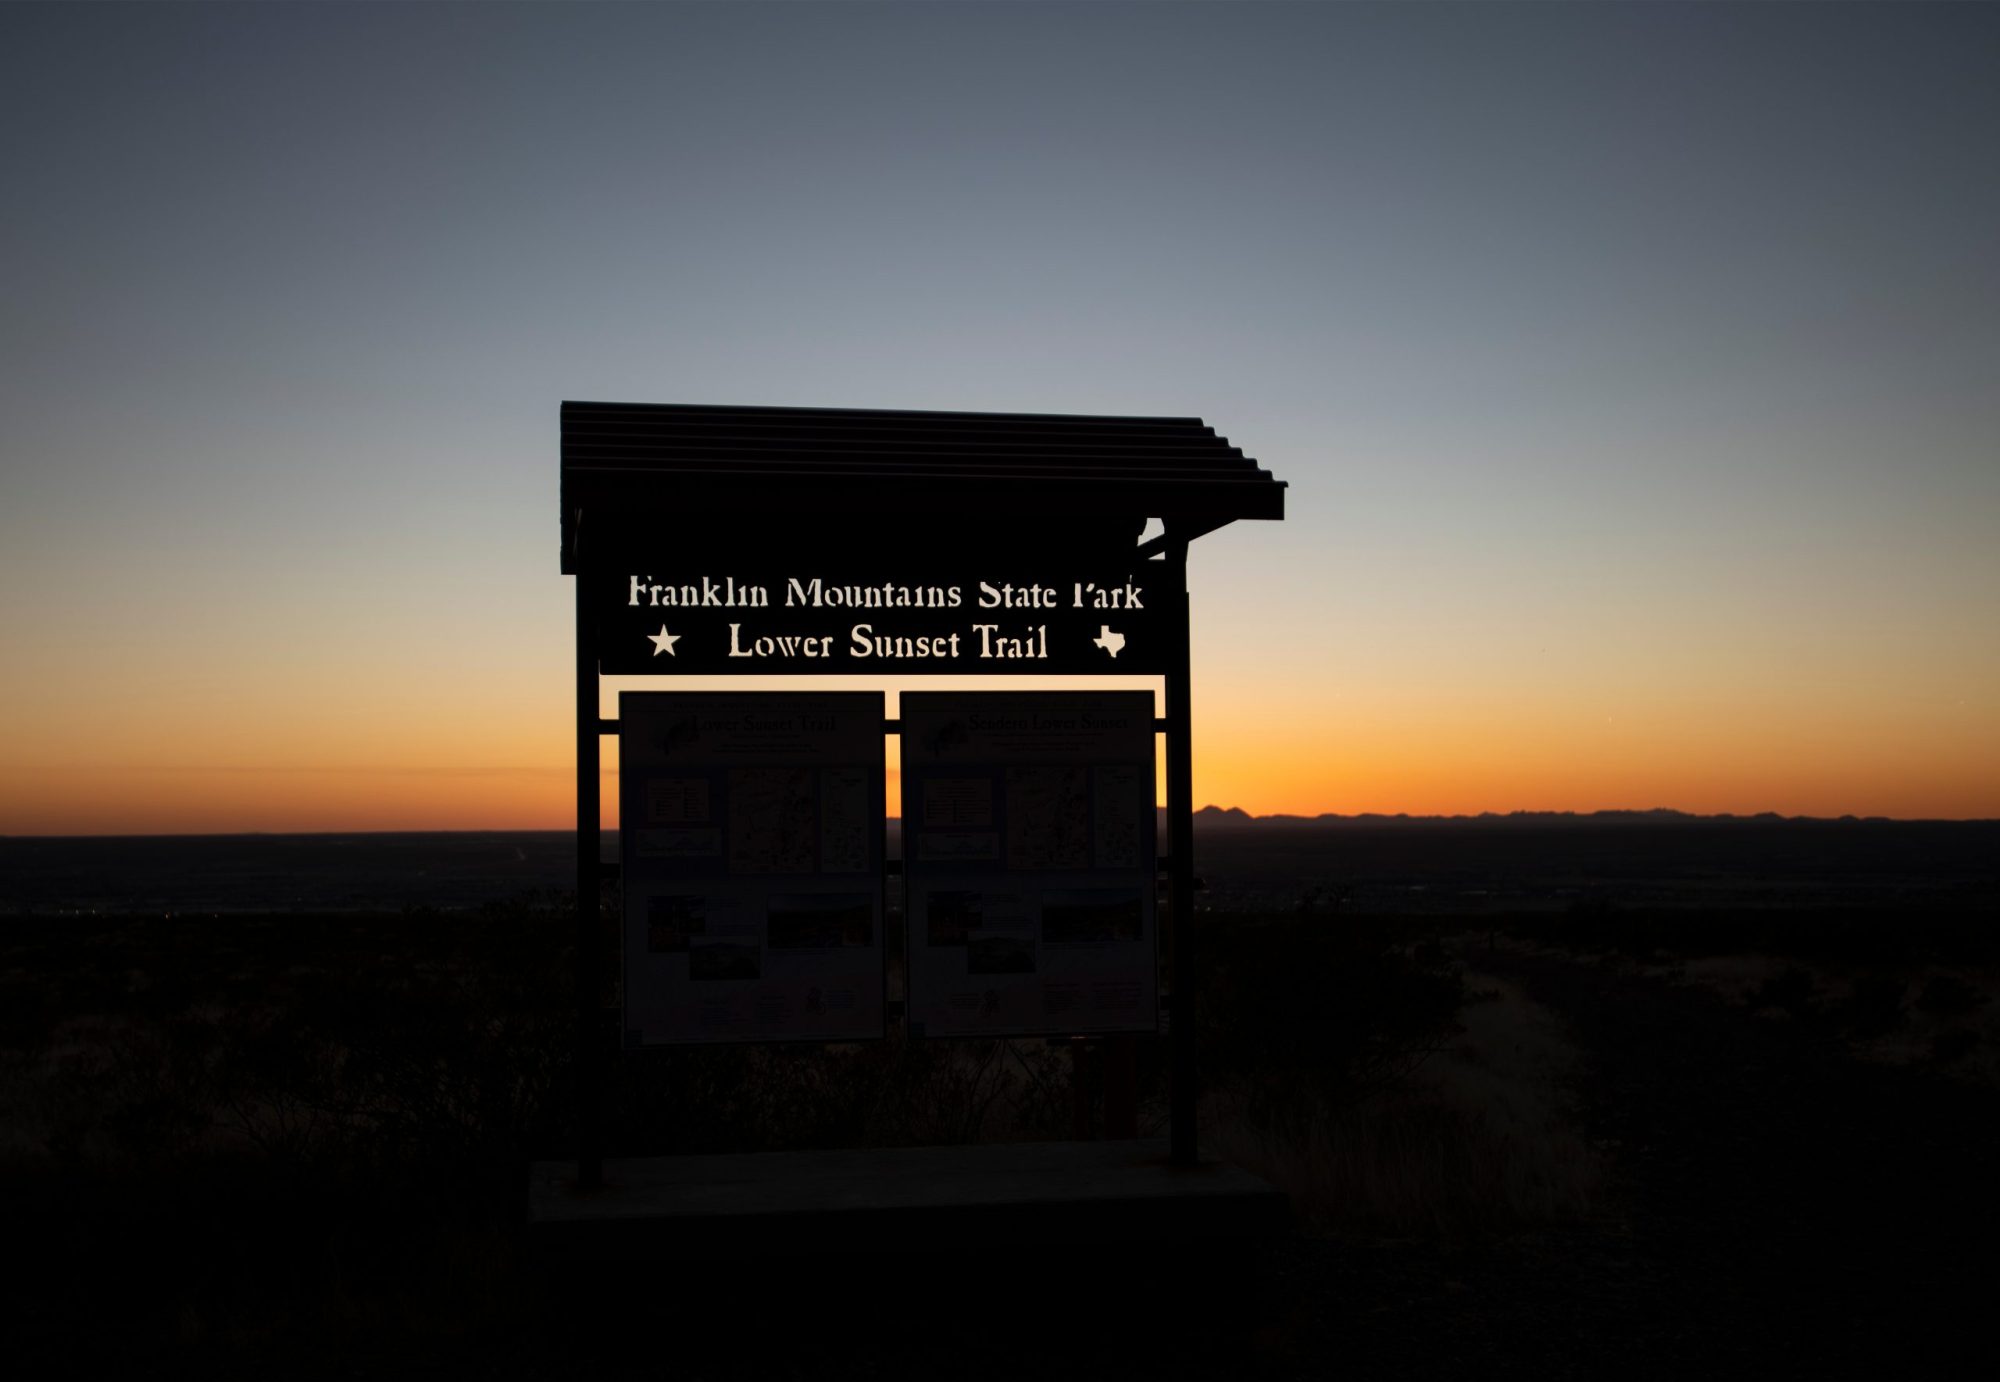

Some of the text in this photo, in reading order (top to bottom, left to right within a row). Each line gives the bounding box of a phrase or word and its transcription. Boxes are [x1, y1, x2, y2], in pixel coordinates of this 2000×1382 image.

[628, 575, 1144, 609] Franklin Mountains State Park
[728, 623, 1048, 659] Lower Sunset Trail
[692, 714, 836, 731] Lower Sunset Trail
[968, 713, 1129, 730] Sendero Lower Sunset
